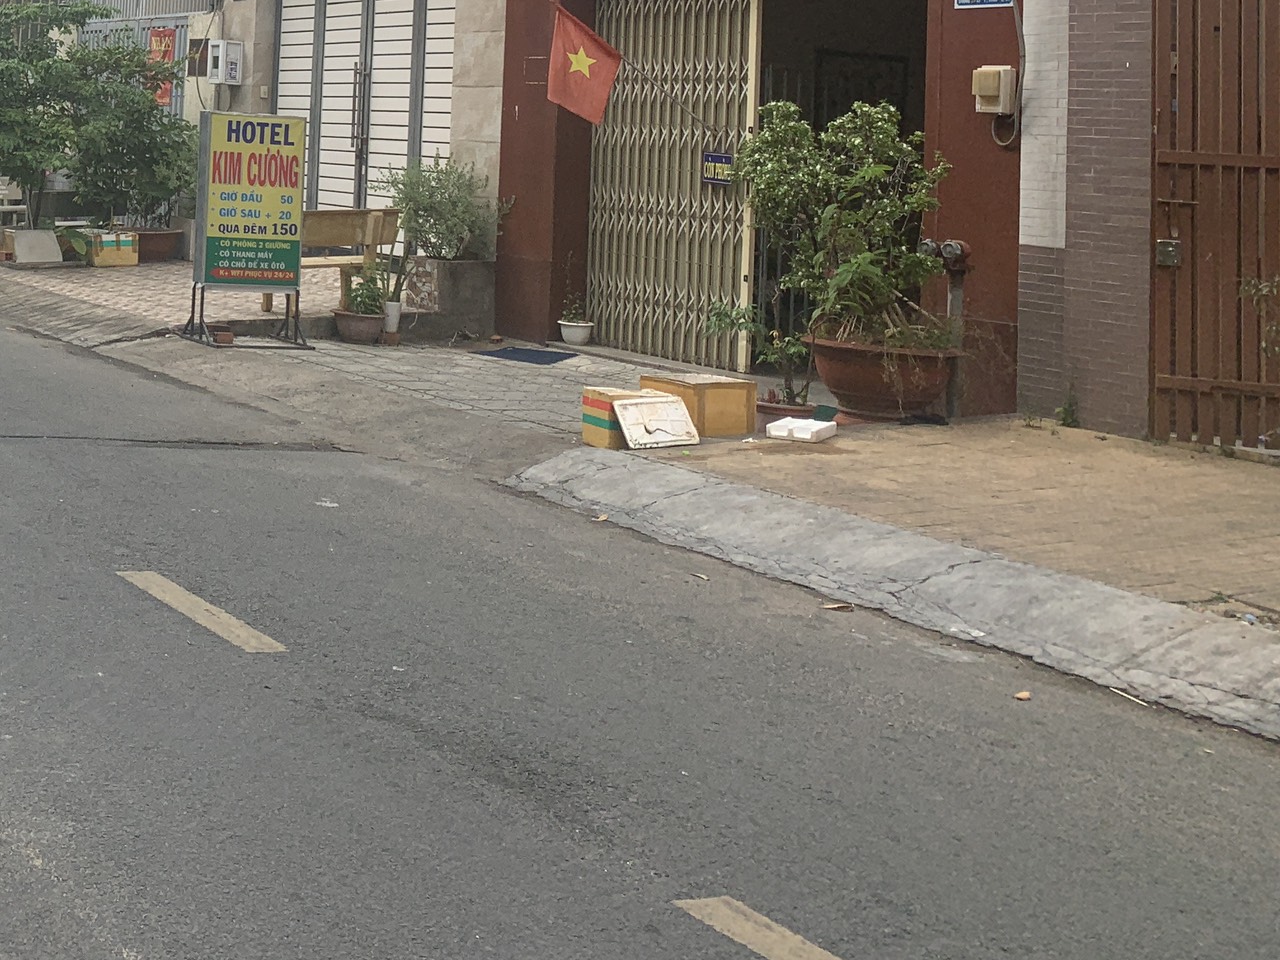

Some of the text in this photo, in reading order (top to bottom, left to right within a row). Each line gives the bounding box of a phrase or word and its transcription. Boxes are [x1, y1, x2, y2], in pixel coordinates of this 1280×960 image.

[226, 120, 295, 146] HOTEL
[211, 148, 299, 189] KIM CƯƠNG
[220, 190, 238, 202] GIỜ
[280, 195, 293, 204] 50
[219, 206, 238, 217] GIỜ
[241, 208, 261, 219] SAU
[278, 211, 292, 220] 20
[218, 223, 298, 236] QUA ĐÊM 150
[219, 249, 273, 259] CÓ THANG MÁY
[274, 271, 294, 279] 24/24
